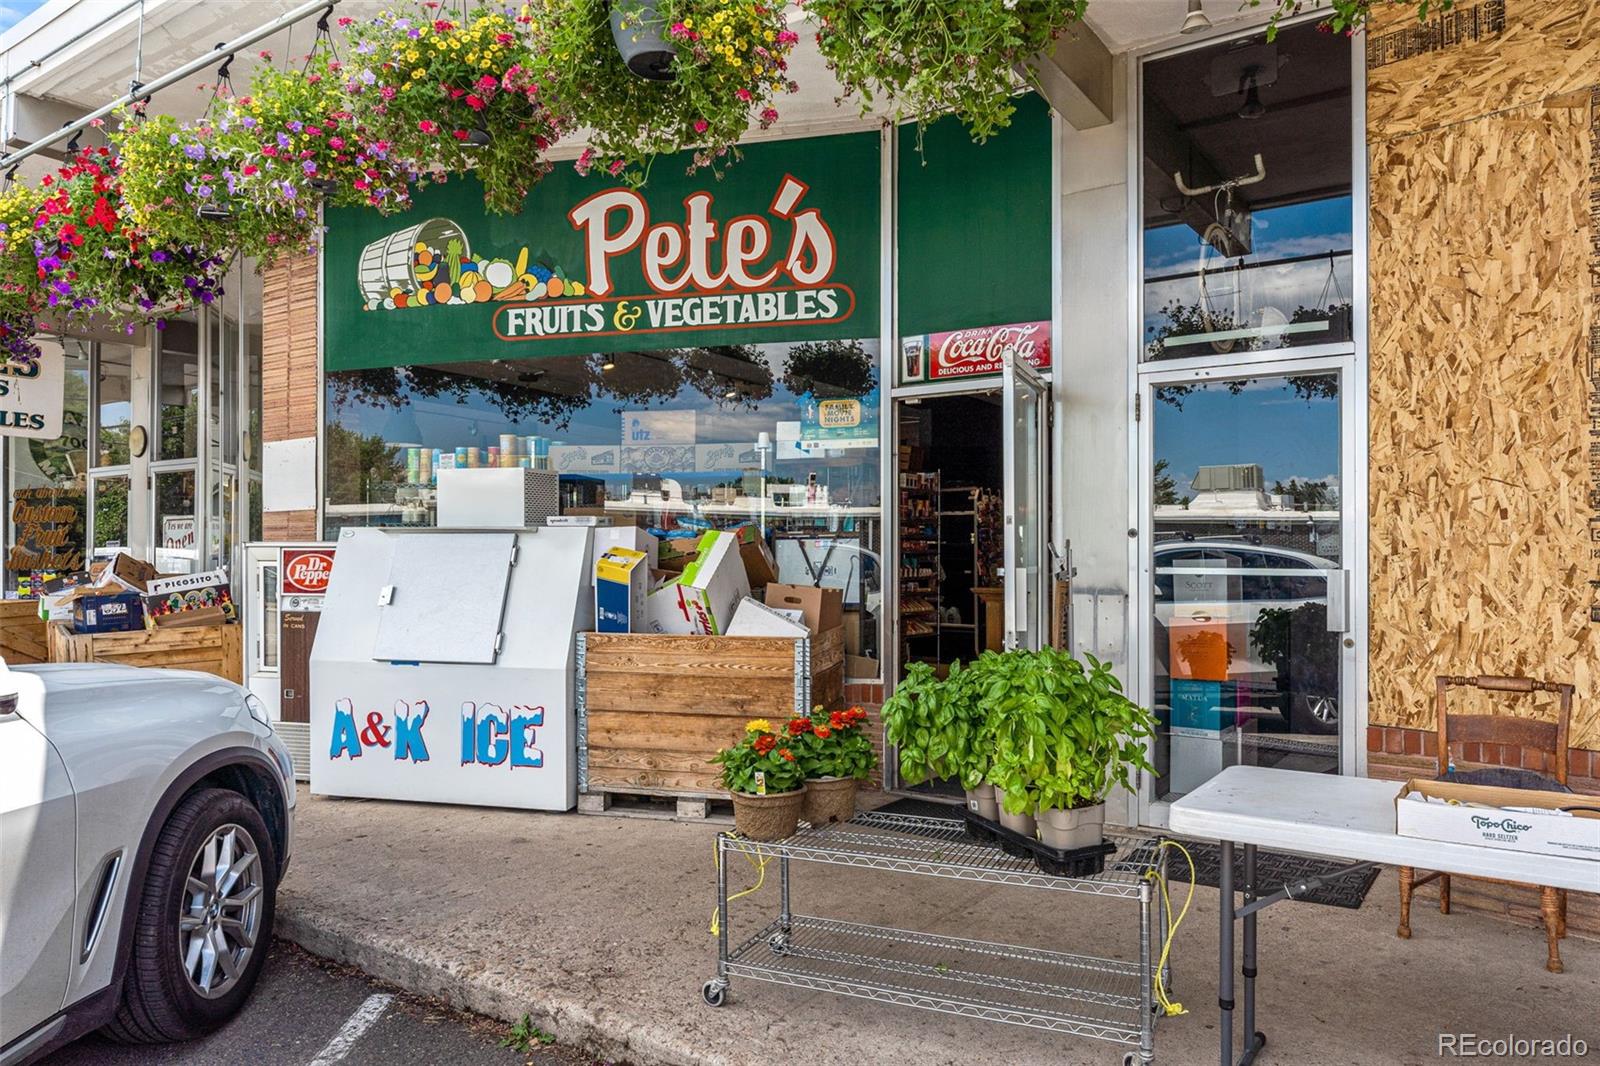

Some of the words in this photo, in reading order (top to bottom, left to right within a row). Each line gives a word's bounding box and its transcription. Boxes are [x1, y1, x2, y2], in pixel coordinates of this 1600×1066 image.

[569, 174, 835, 296] Pete's
[507, 304, 604, 336] FRUITS
[613, 301, 642, 331] &
[645, 289, 838, 328] VEGETABLES
[964, 328, 993, 338] DRINK
[938, 365, 974, 376] DELICIOUS
[976, 363, 993, 371] AND
[13, 500, 77, 523] Custom
[18, 523, 74, 548] Fruit
[293, 564, 330, 586] Peppe
[306, 557, 328, 571] Dr
[164, 575, 212, 589] PICOSITO
[329, 698, 431, 765] A&K
[460, 700, 545, 770] ICE
[1471, 815, 1500, 829] Topo
[1500, 818, 1531, 833] Chico
